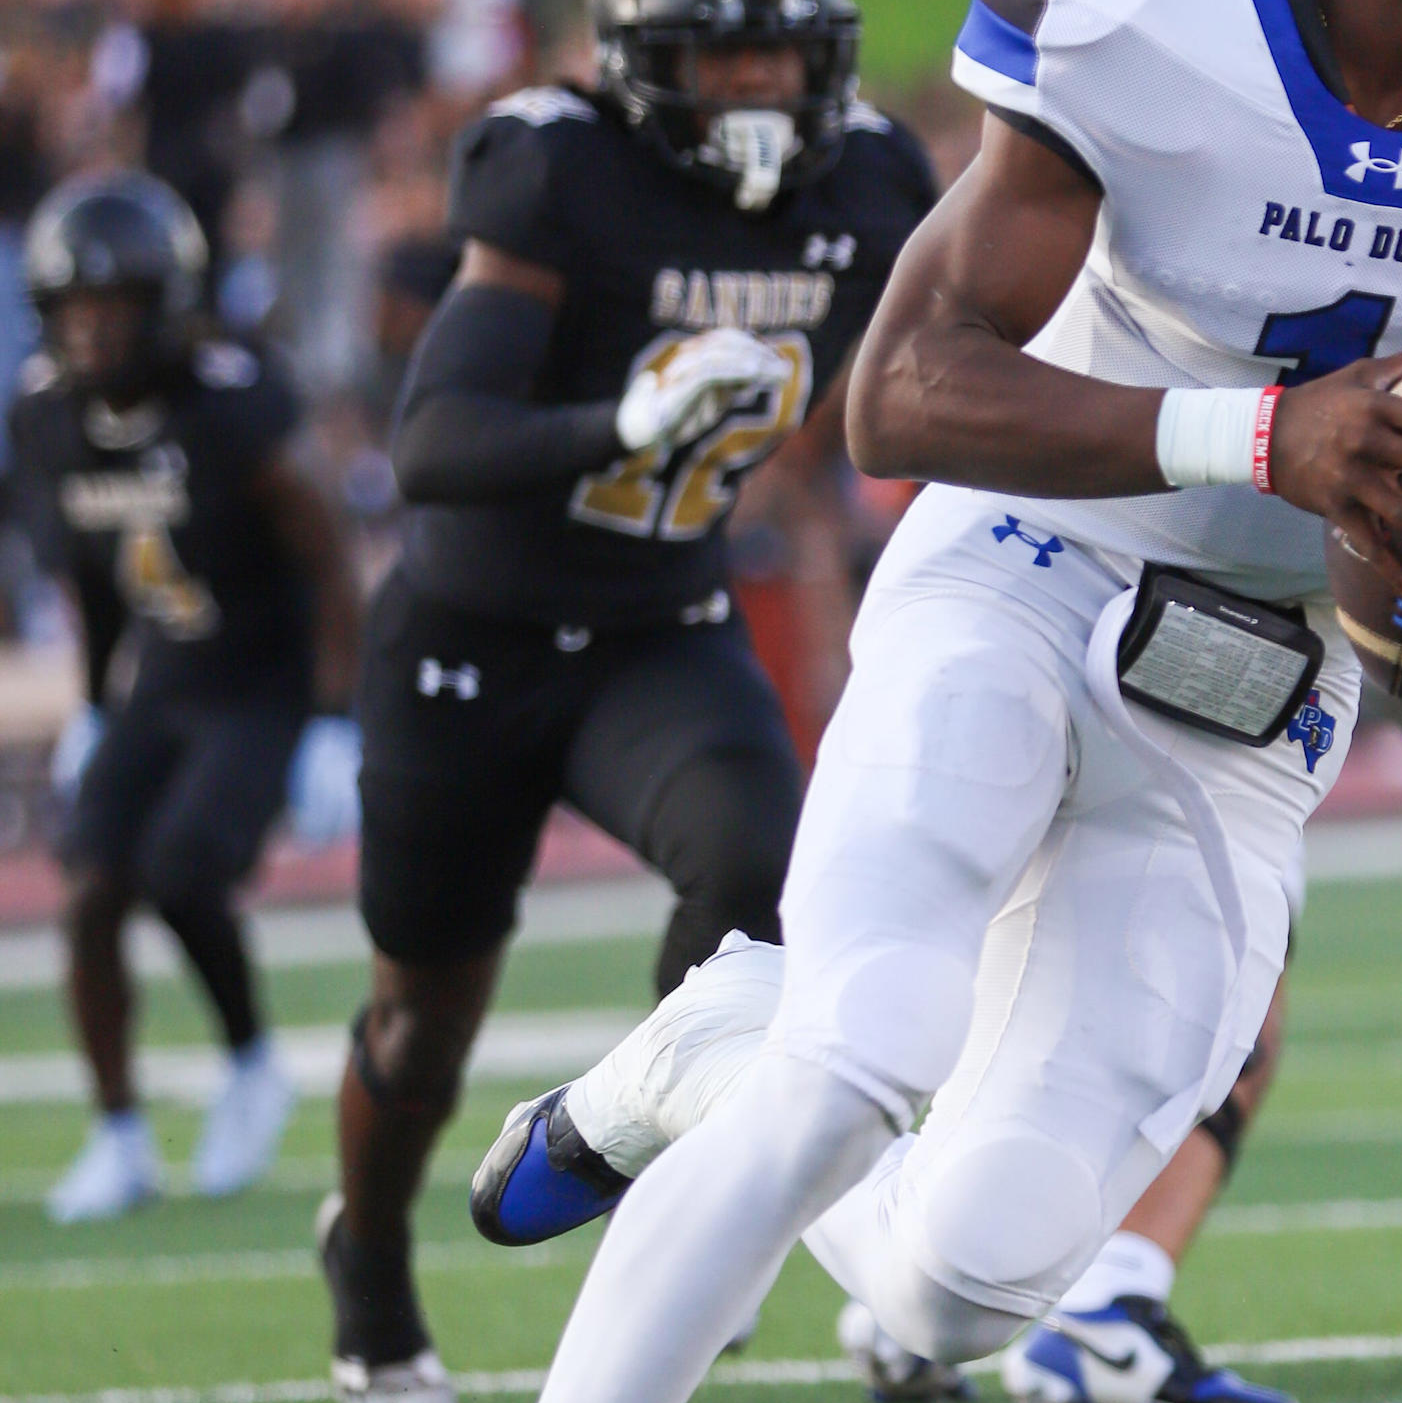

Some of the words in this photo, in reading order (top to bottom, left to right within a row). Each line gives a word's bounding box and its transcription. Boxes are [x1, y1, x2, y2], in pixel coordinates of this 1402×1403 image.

[1259, 200, 1356, 252] PALO
[1257, 394, 1277, 432] WRECK
[1255, 460, 1271, 489] TECH
